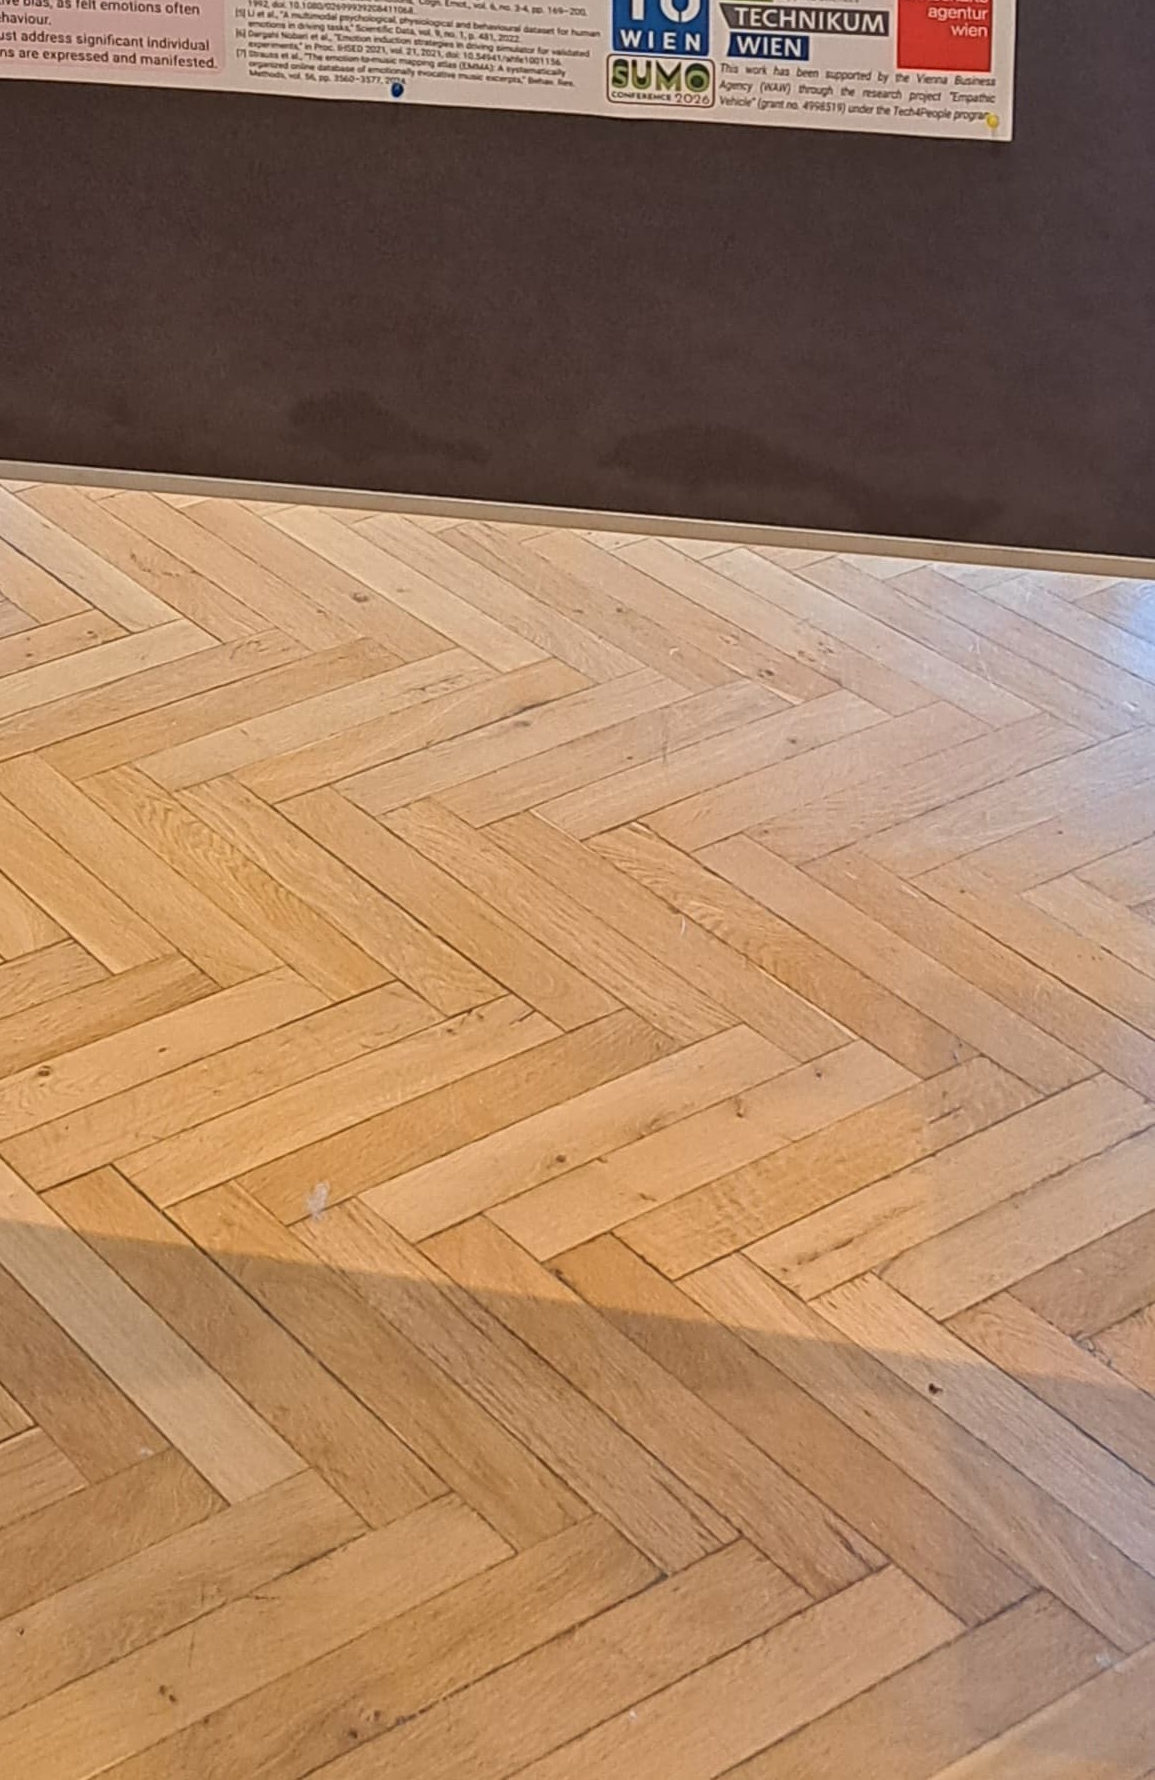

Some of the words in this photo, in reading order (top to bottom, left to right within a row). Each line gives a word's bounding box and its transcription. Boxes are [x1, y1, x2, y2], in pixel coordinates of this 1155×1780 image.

[735, 7, 886, 34] TECHNIKUM
[928, 5, 988, 21] agentur
[20, 30, 72, 44] address
[76, 33, 144, 48] significant
[147, 35, 209, 51] individual
[620, 29, 701, 52] WIEN
[951, 23, 988, 38] wien
[736, 35, 802, 58] WIEN
[612, 58, 711, 93] SUMO
[611, 92, 672, 101] CONFERENCE
[674, 92, 710, 105] 2026
